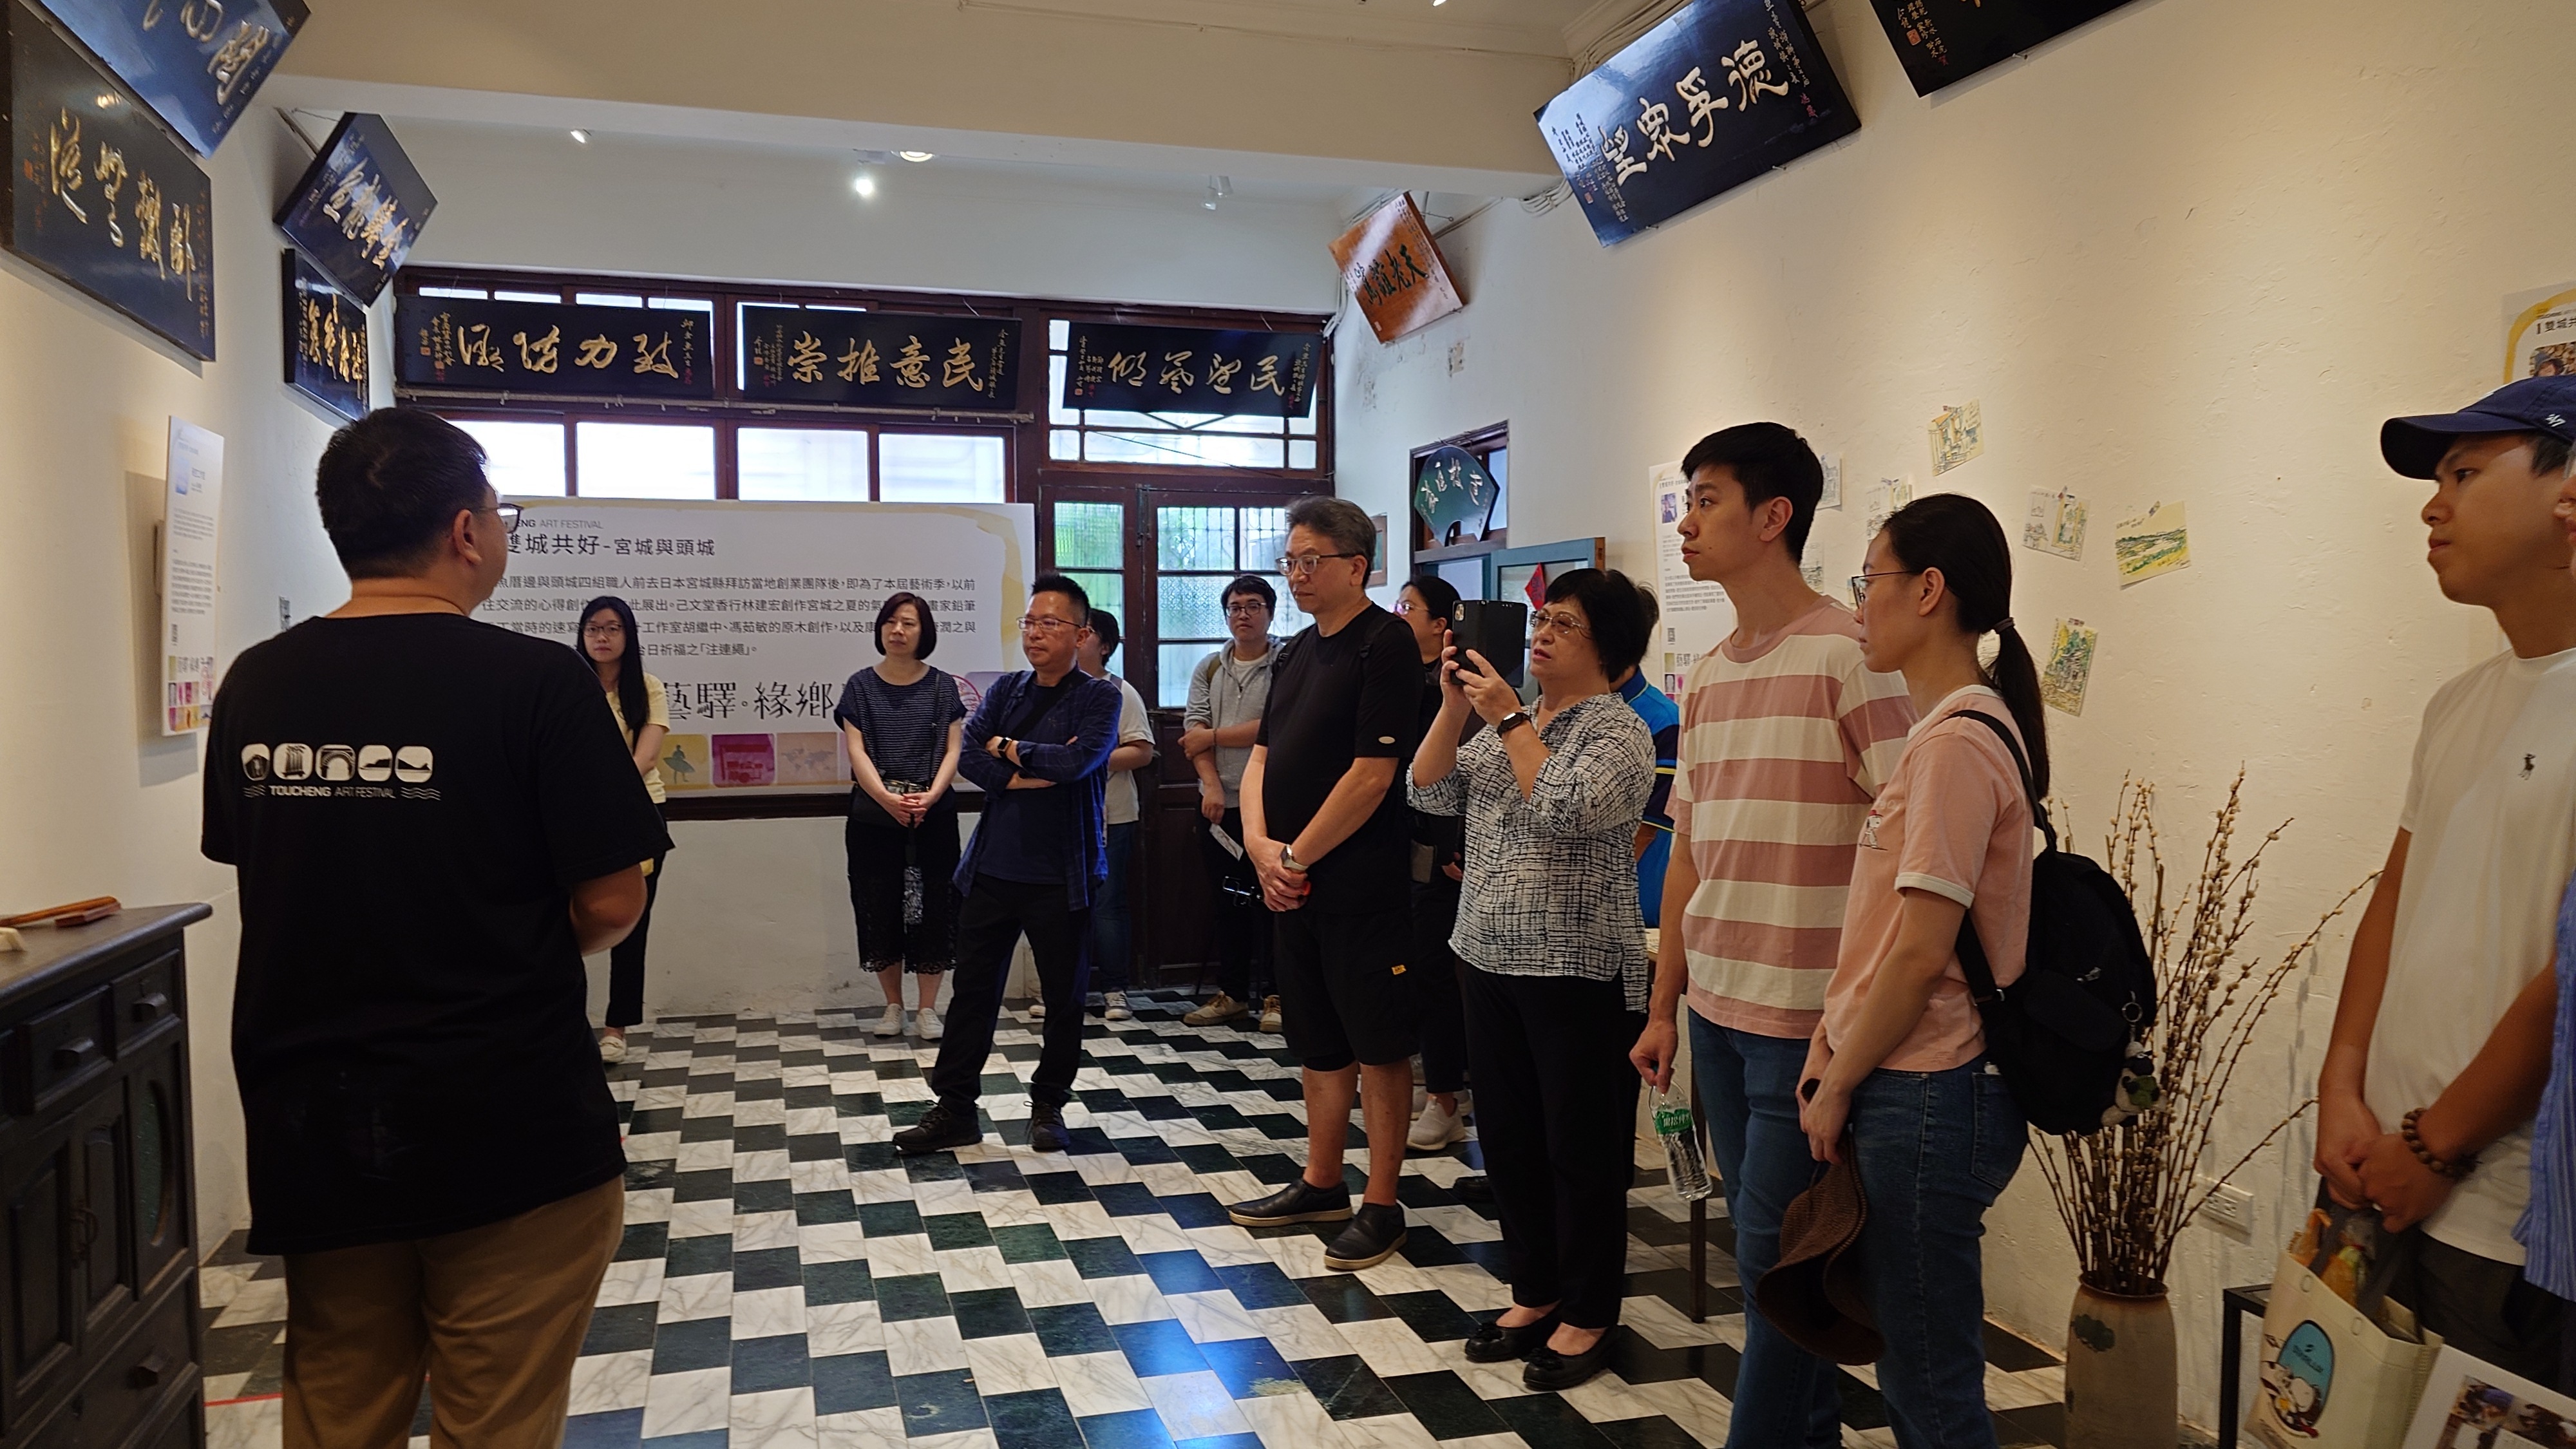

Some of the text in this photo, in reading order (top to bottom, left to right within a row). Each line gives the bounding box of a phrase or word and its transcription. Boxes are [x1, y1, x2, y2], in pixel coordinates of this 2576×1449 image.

[787, 330, 983, 392] 民意推崇
[540, 520, 558, 528] ART
[560, 520, 603, 529] FESTIVAL
[269, 785, 396, 799] TOUCHENG ART FESTIVAL
